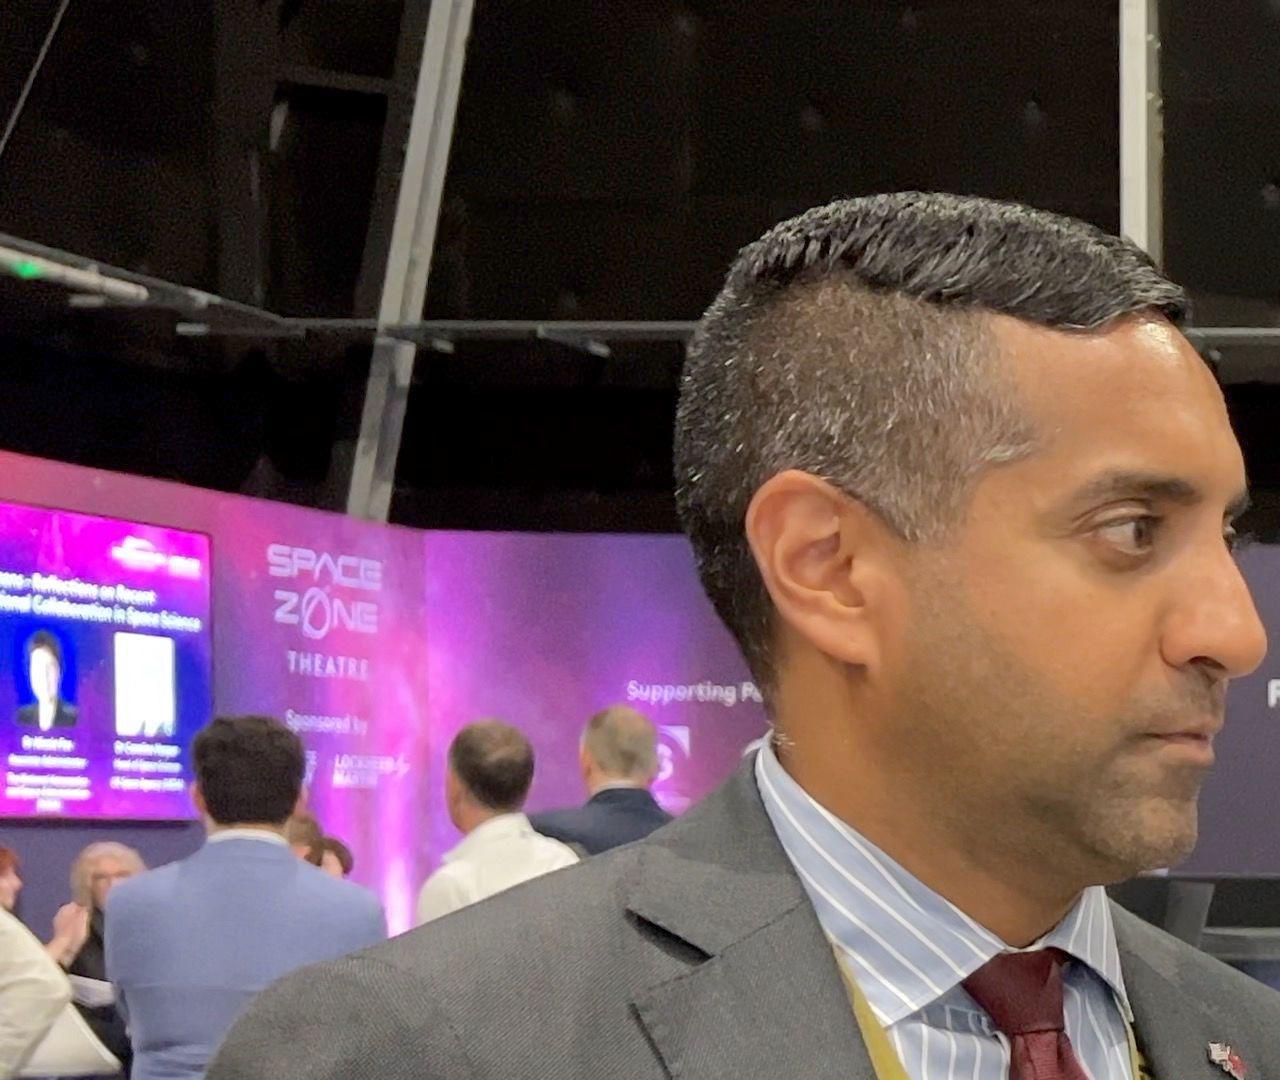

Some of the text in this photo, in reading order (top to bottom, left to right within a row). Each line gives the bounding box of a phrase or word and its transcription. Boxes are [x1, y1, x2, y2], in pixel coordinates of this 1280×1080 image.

[267, 543, 382, 591] SPACE
[274, 585, 378, 640] ZONE
[287, 650, 370, 680] THEATRE
[627, 679, 737, 707] Supporting
